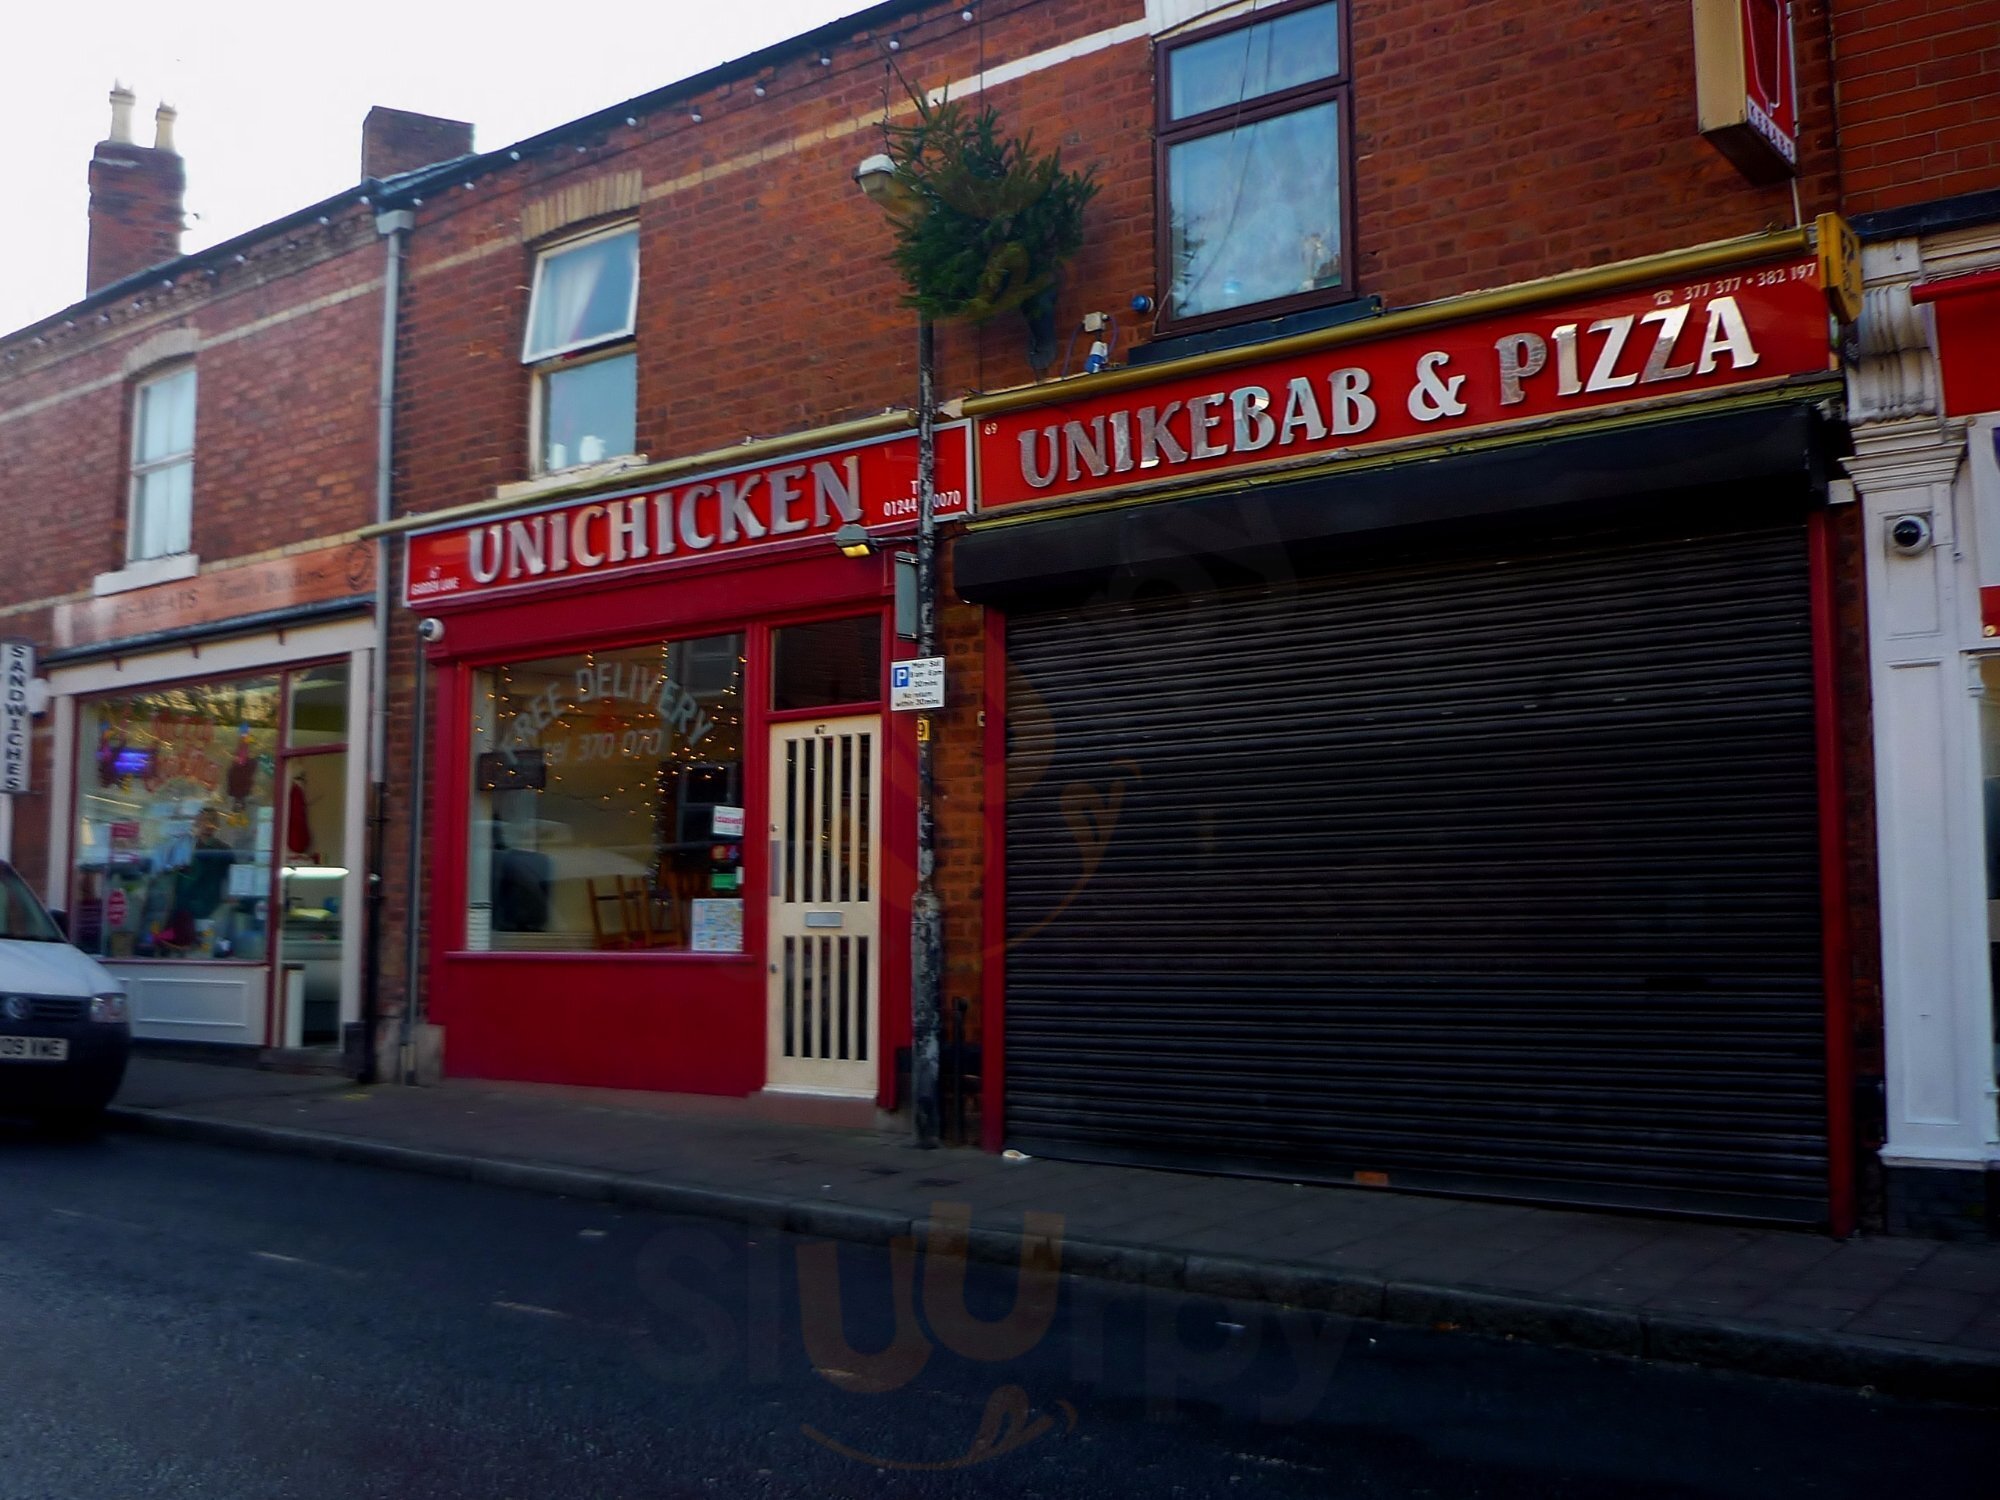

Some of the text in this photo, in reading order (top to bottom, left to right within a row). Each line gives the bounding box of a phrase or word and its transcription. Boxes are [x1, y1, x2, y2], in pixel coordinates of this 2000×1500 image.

[1684, 262, 1818, 301] 377 377 382 197
[984, 422, 998, 435] 69
[1018, 296, 1760, 488] UNIKEBAB & PIZZA
[468, 455, 863, 583] UNICHICKEN
[883, 490, 962, 517] 01244 0070
[5, 645, 27, 790] SANDWICHES
[575, 662, 714, 746] DELIVERY
